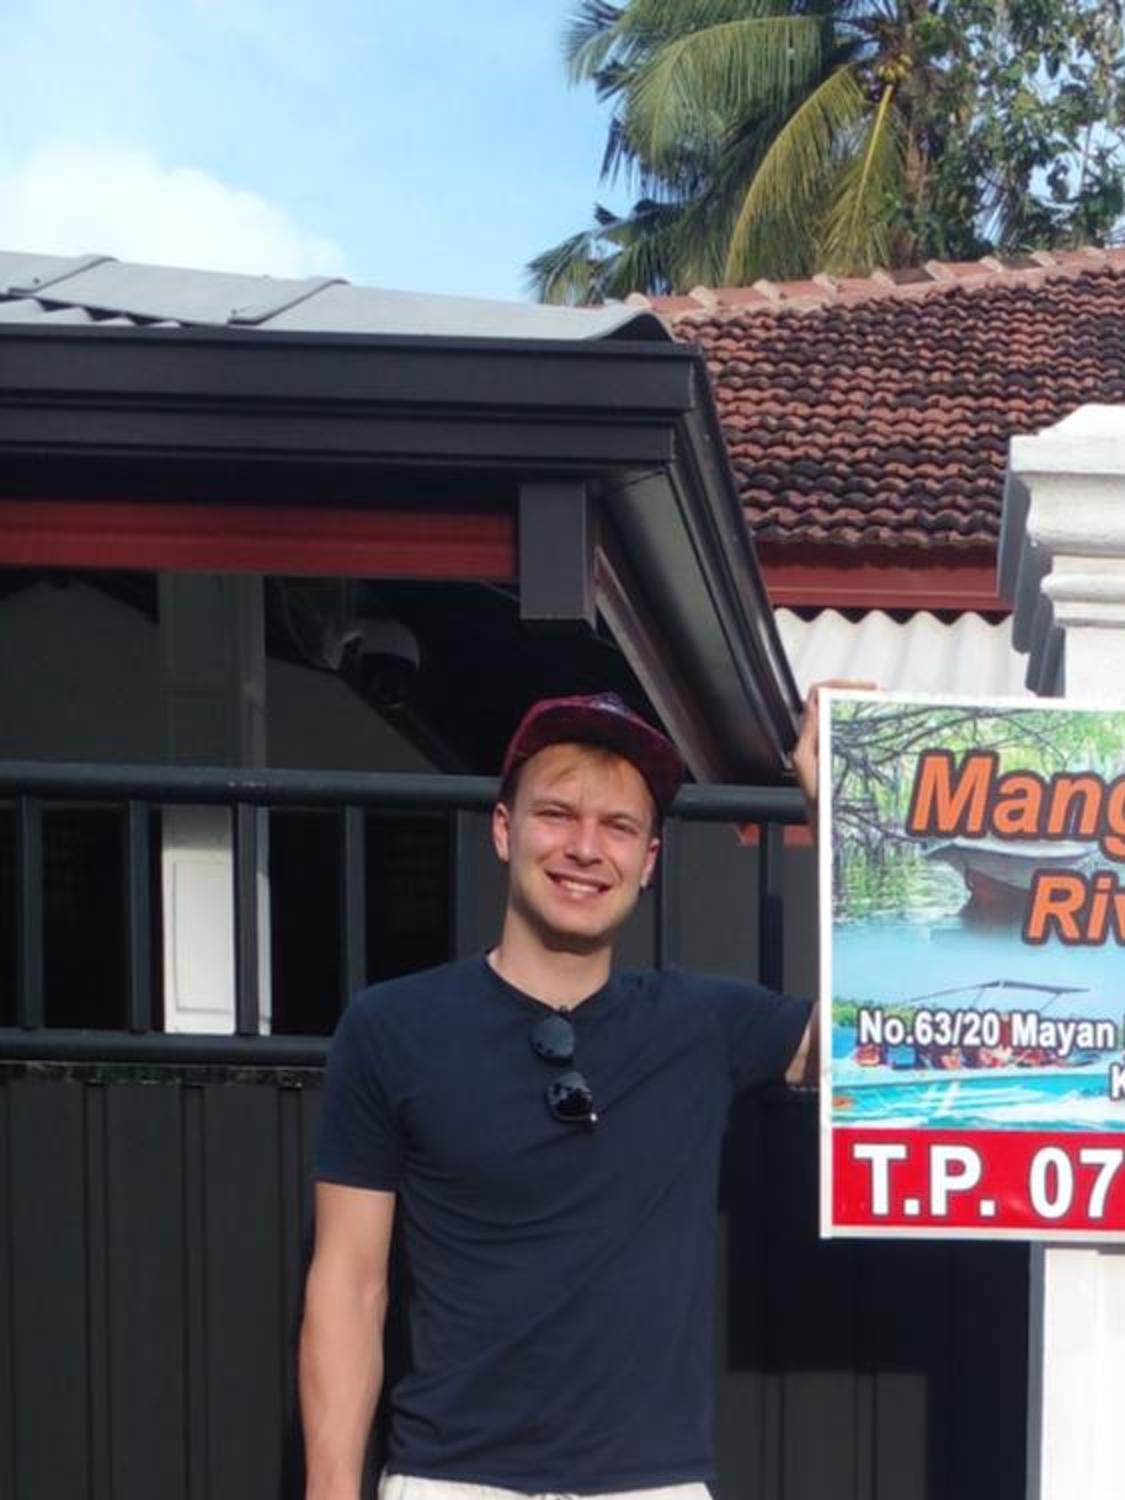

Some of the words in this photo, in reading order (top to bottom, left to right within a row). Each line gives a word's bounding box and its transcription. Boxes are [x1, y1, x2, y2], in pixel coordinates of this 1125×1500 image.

[858, 1009, 1001, 1046] No.63/20
[1010, 1012, 1117, 1057] Mayan
[853, 1143, 996, 1216] T.P.
